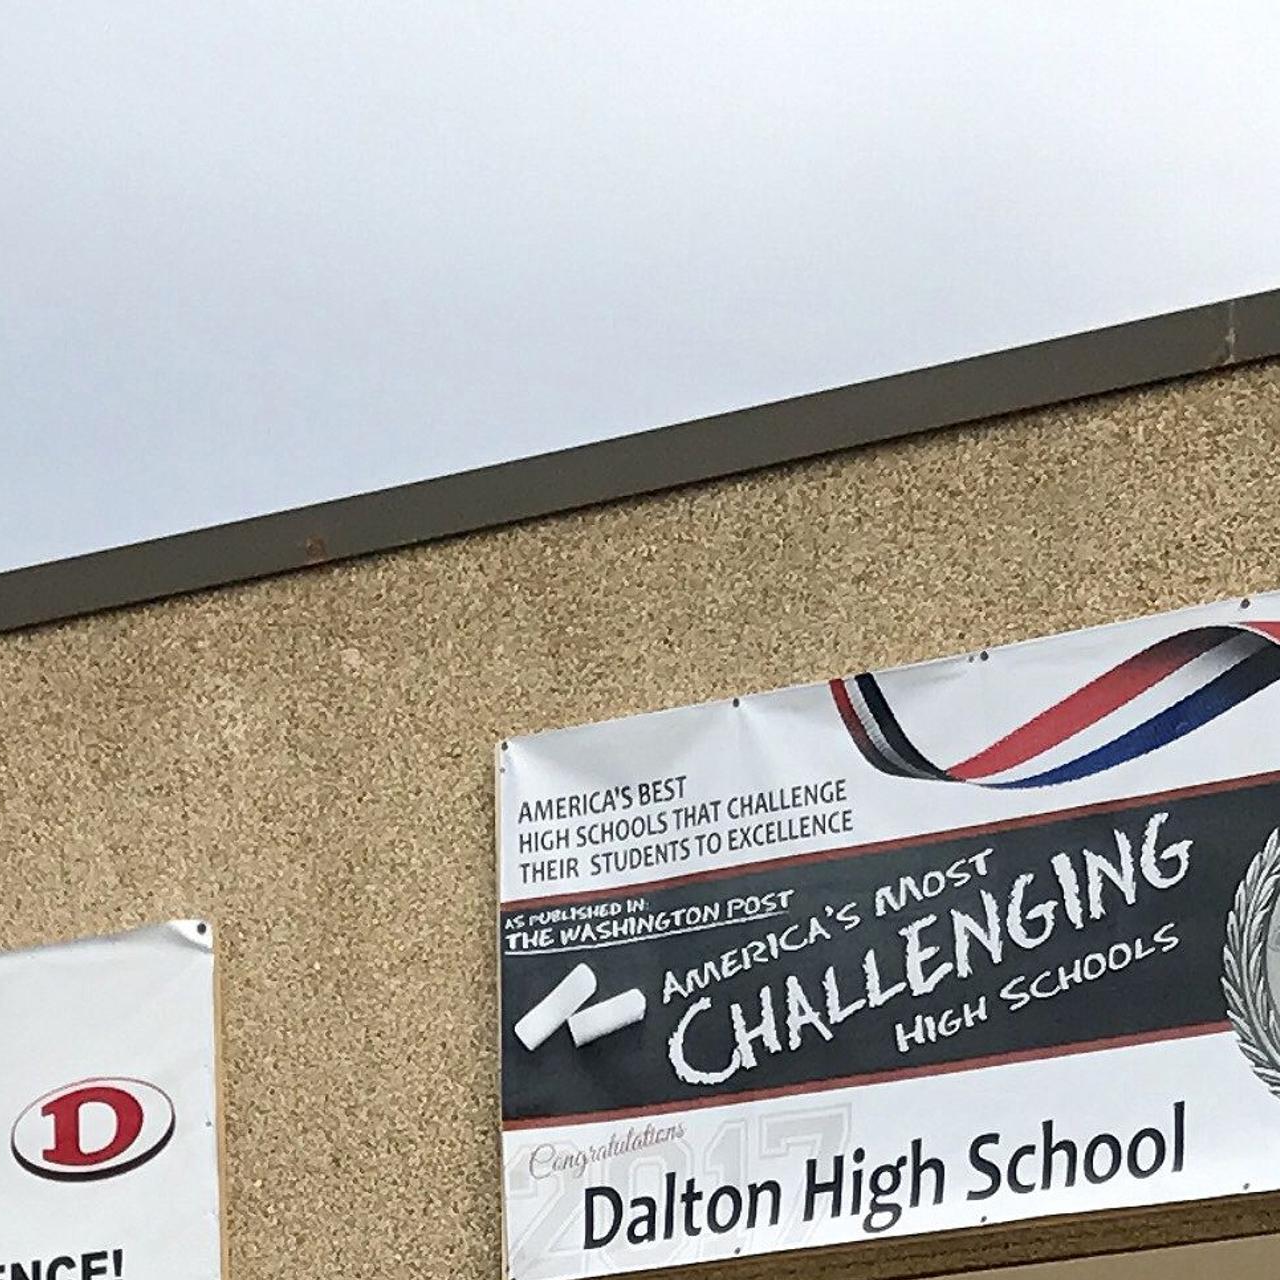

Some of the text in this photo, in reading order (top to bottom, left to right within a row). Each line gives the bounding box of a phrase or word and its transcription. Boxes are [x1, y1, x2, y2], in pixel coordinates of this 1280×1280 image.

[519, 776, 686, 823] AMERICA'S BEST
[520, 779, 847, 853] HIGH SCHOOLS THAT CHALLENGE
[520, 810, 853, 884] THEIR STUDENTS TO EXCELLENCE
[505, 914, 525, 930] AS
[529, 902, 621, 926] PUBLISHED
[505, 889, 794, 949] THE WASHINGTON POST
[661, 848, 994, 1004] AMERICA'S MOST
[668, 811, 1195, 1086] CHALLENGING
[895, 922, 1182, 1053] HIGH SCHOOLS
[41, 1086, 144, 1167] D
[529, 1121, 686, 1180] Congratulations
[583, 1100, 1185, 1250] Dalton High School
